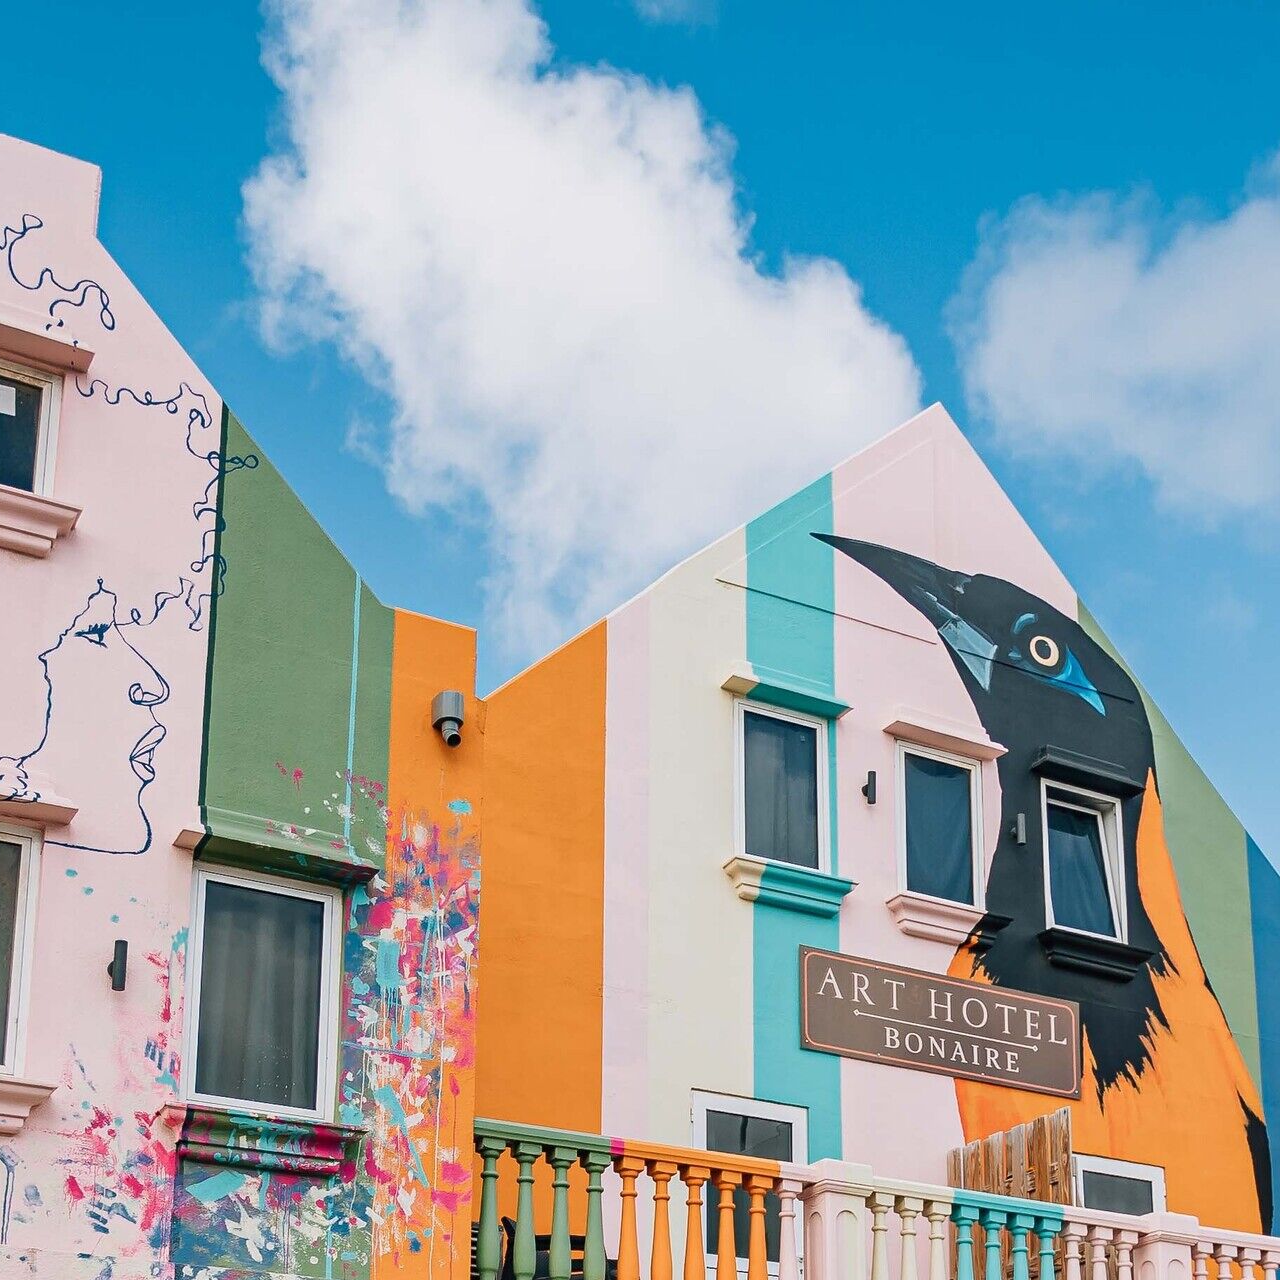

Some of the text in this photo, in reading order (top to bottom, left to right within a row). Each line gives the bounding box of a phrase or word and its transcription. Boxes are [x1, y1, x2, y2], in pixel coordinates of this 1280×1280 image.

[817, 966, 1068, 1046] ART HOTEL
[883, 1026, 1020, 1074] BONAIRE
